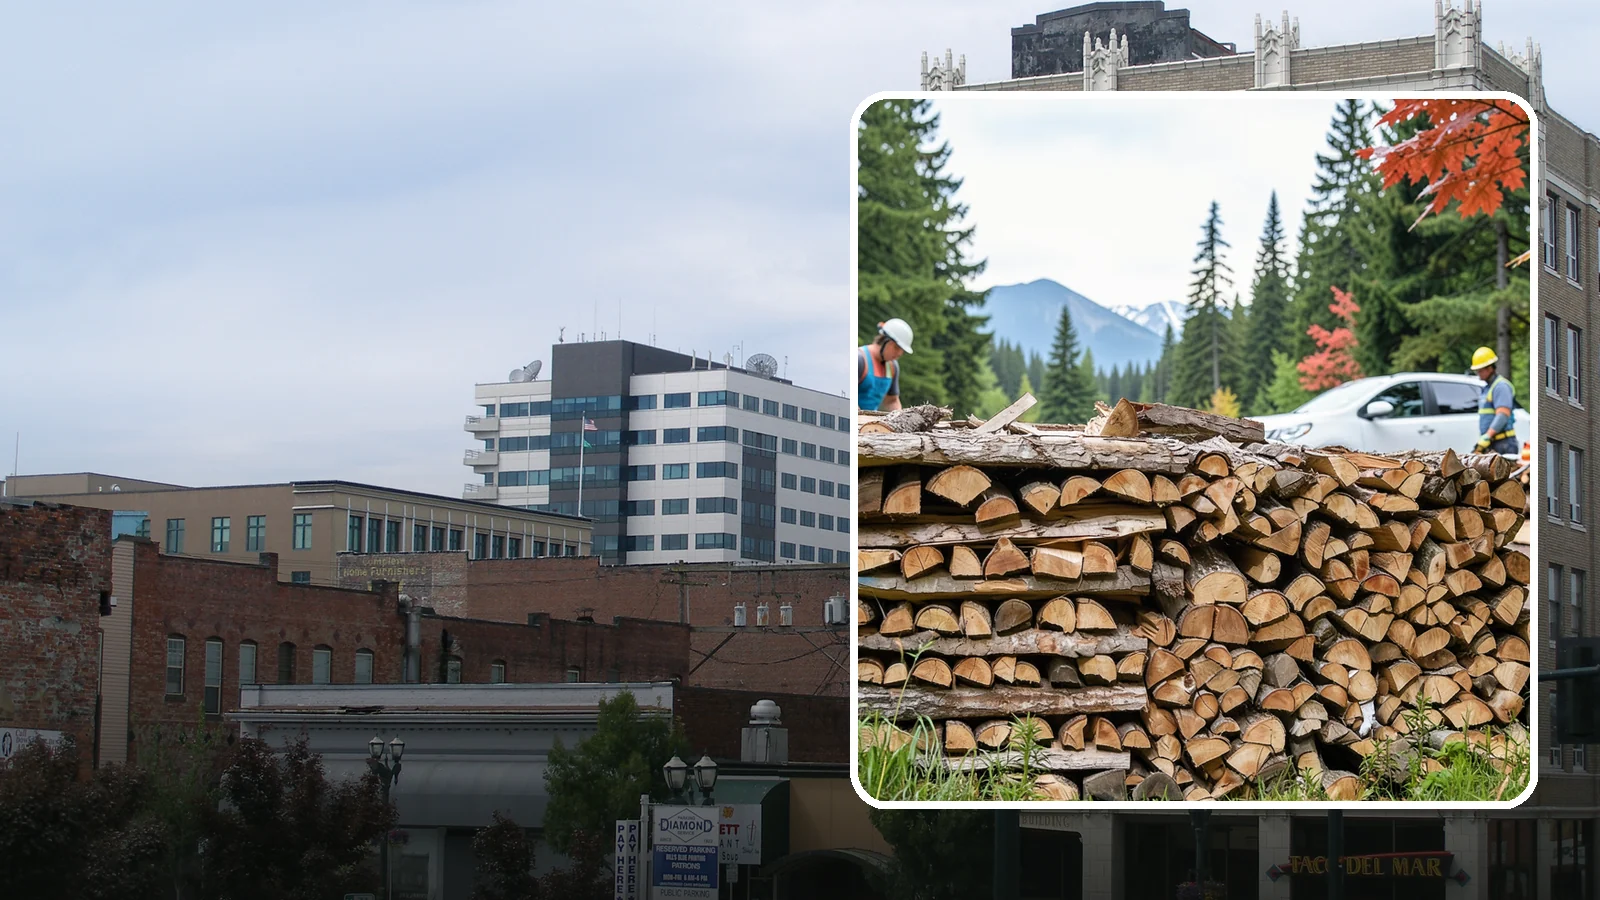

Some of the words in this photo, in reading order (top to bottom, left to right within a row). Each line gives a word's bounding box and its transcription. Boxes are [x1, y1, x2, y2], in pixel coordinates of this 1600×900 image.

[343, 568, 368, 577] Home
[370, 566, 427, 576] Furnishers
[660, 818, 713, 833] DIAMOND
[1022, 815, 1070, 828] BUILDING
[617, 825, 625, 852] PAY
[628, 824, 637, 852] PAY
[655, 845, 688, 853] RESERVED
[689, 846, 716, 854] PARKING
[721, 851, 739, 862] Soup
[671, 862, 701, 870] PATRONS
[1346, 855, 1385, 875] DEL
[1392, 857, 1443, 877] MAR
[616, 856, 625, 893] HERE
[627, 856, 636, 893] HERE
[660, 888, 682, 897] PUBLIC
[683, 889, 710, 899] PARKING
